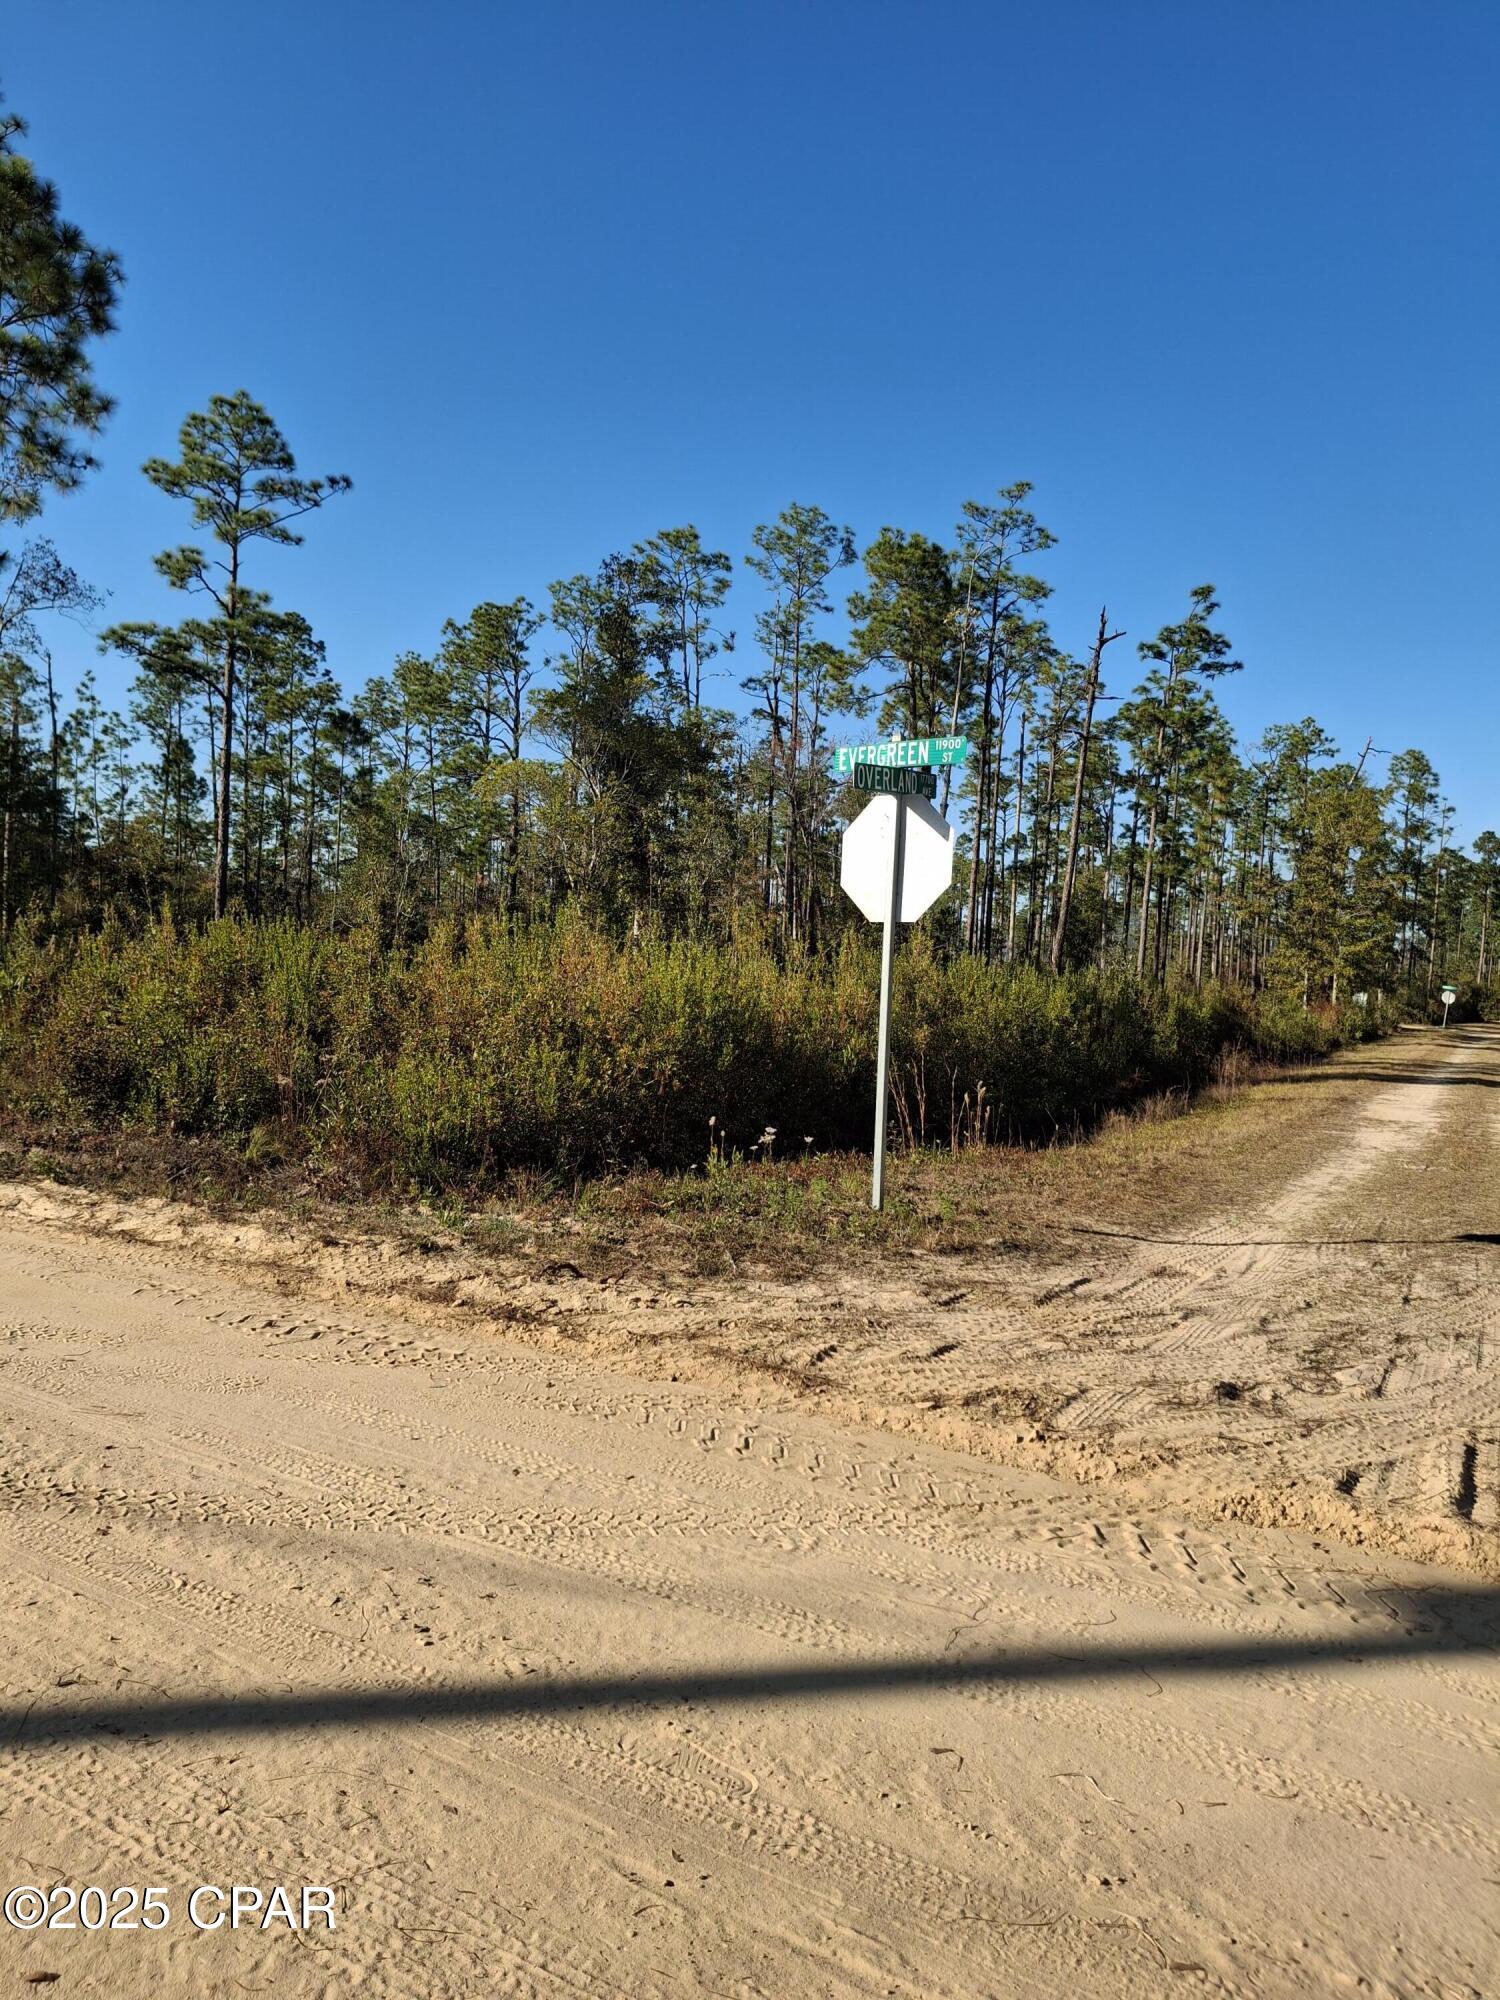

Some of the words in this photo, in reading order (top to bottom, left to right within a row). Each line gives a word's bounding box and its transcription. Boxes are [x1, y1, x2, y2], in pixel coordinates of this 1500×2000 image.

[936, 739, 961, 751] 11900
[838, 740, 929, 771] EVERGREEN
[942, 752, 953, 763] ST
[857, 765, 918, 794] OVERLAND
[922, 786, 933, 797] AVE
